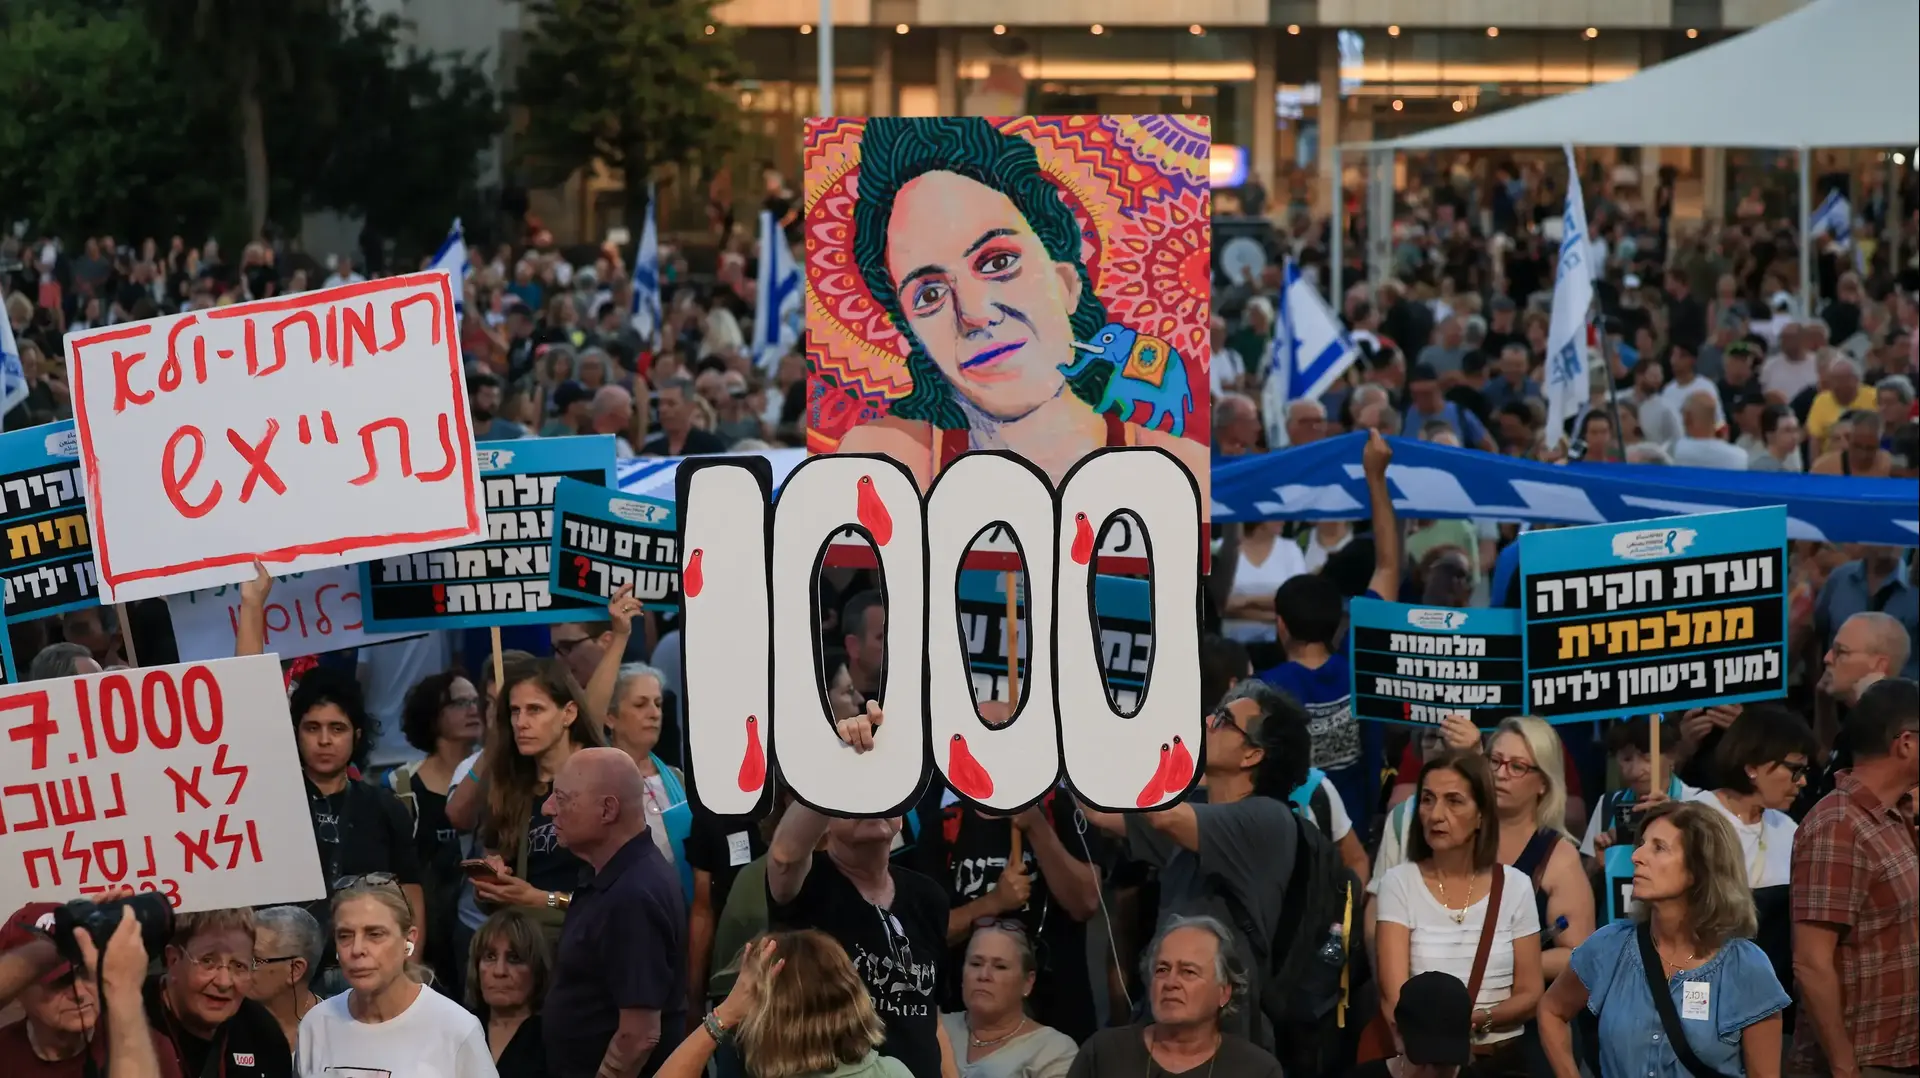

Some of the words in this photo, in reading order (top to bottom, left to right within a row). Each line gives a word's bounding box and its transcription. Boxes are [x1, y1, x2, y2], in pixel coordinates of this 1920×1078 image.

[564, 519, 608, 553] עוד
[614, 530, 651, 561] דם
[1536, 568, 1663, 613] חקירה
[1673, 556, 1773, 599] ועדת
[675, 445, 1206, 818] 1000
[1389, 633, 1486, 656] מלחמות
[1558, 606, 1754, 660] ממלכתית
[1375, 677, 1501, 704] כשאימהות
[1396, 657, 1479, 680] נגמרות
[1532, 669, 1611, 706] ילדינו
[1617, 661, 1707, 705] ביטחון
[1713, 649, 1780, 694] למען
[164, 744, 249, 814] לא
[22, 830, 157, 889] נסלח
[174, 814, 264, 874] ולא
